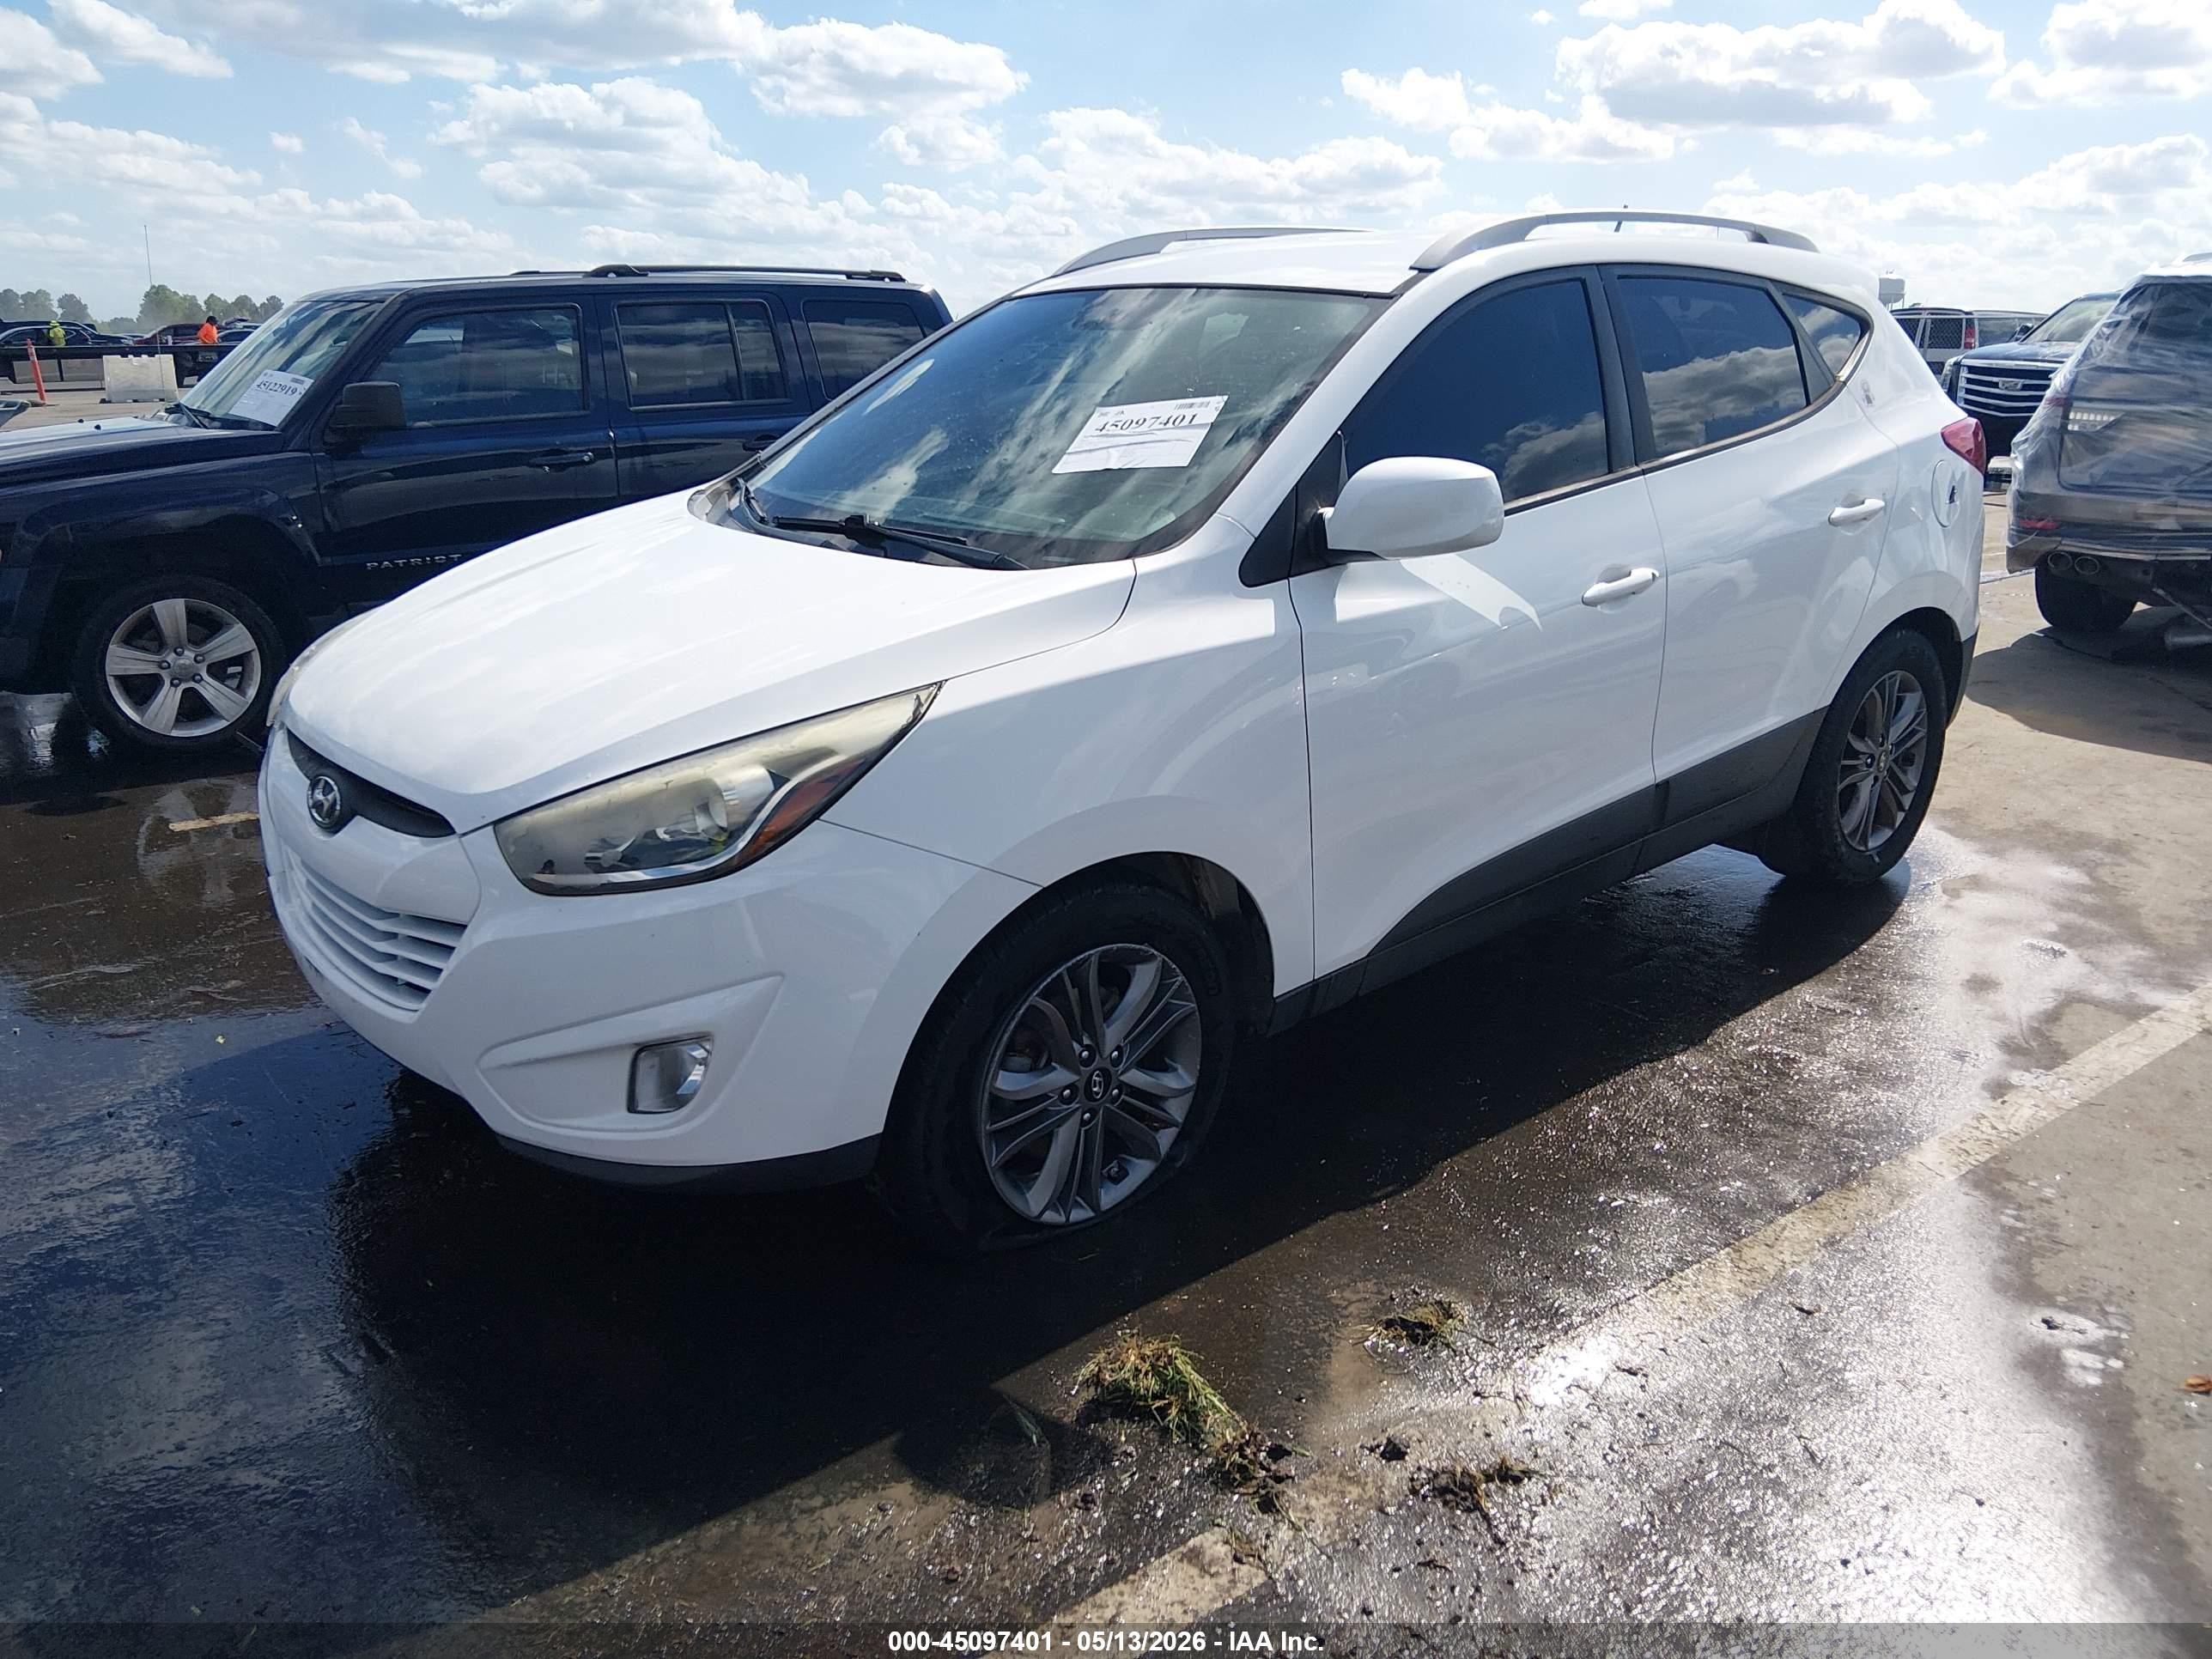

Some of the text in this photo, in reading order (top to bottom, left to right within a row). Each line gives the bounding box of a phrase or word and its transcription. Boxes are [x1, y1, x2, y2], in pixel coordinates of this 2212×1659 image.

[256, 380, 298, 396] 45122919
[1095, 412, 1199, 433] 45097401
[366, 554, 462, 570] PATRIOT
